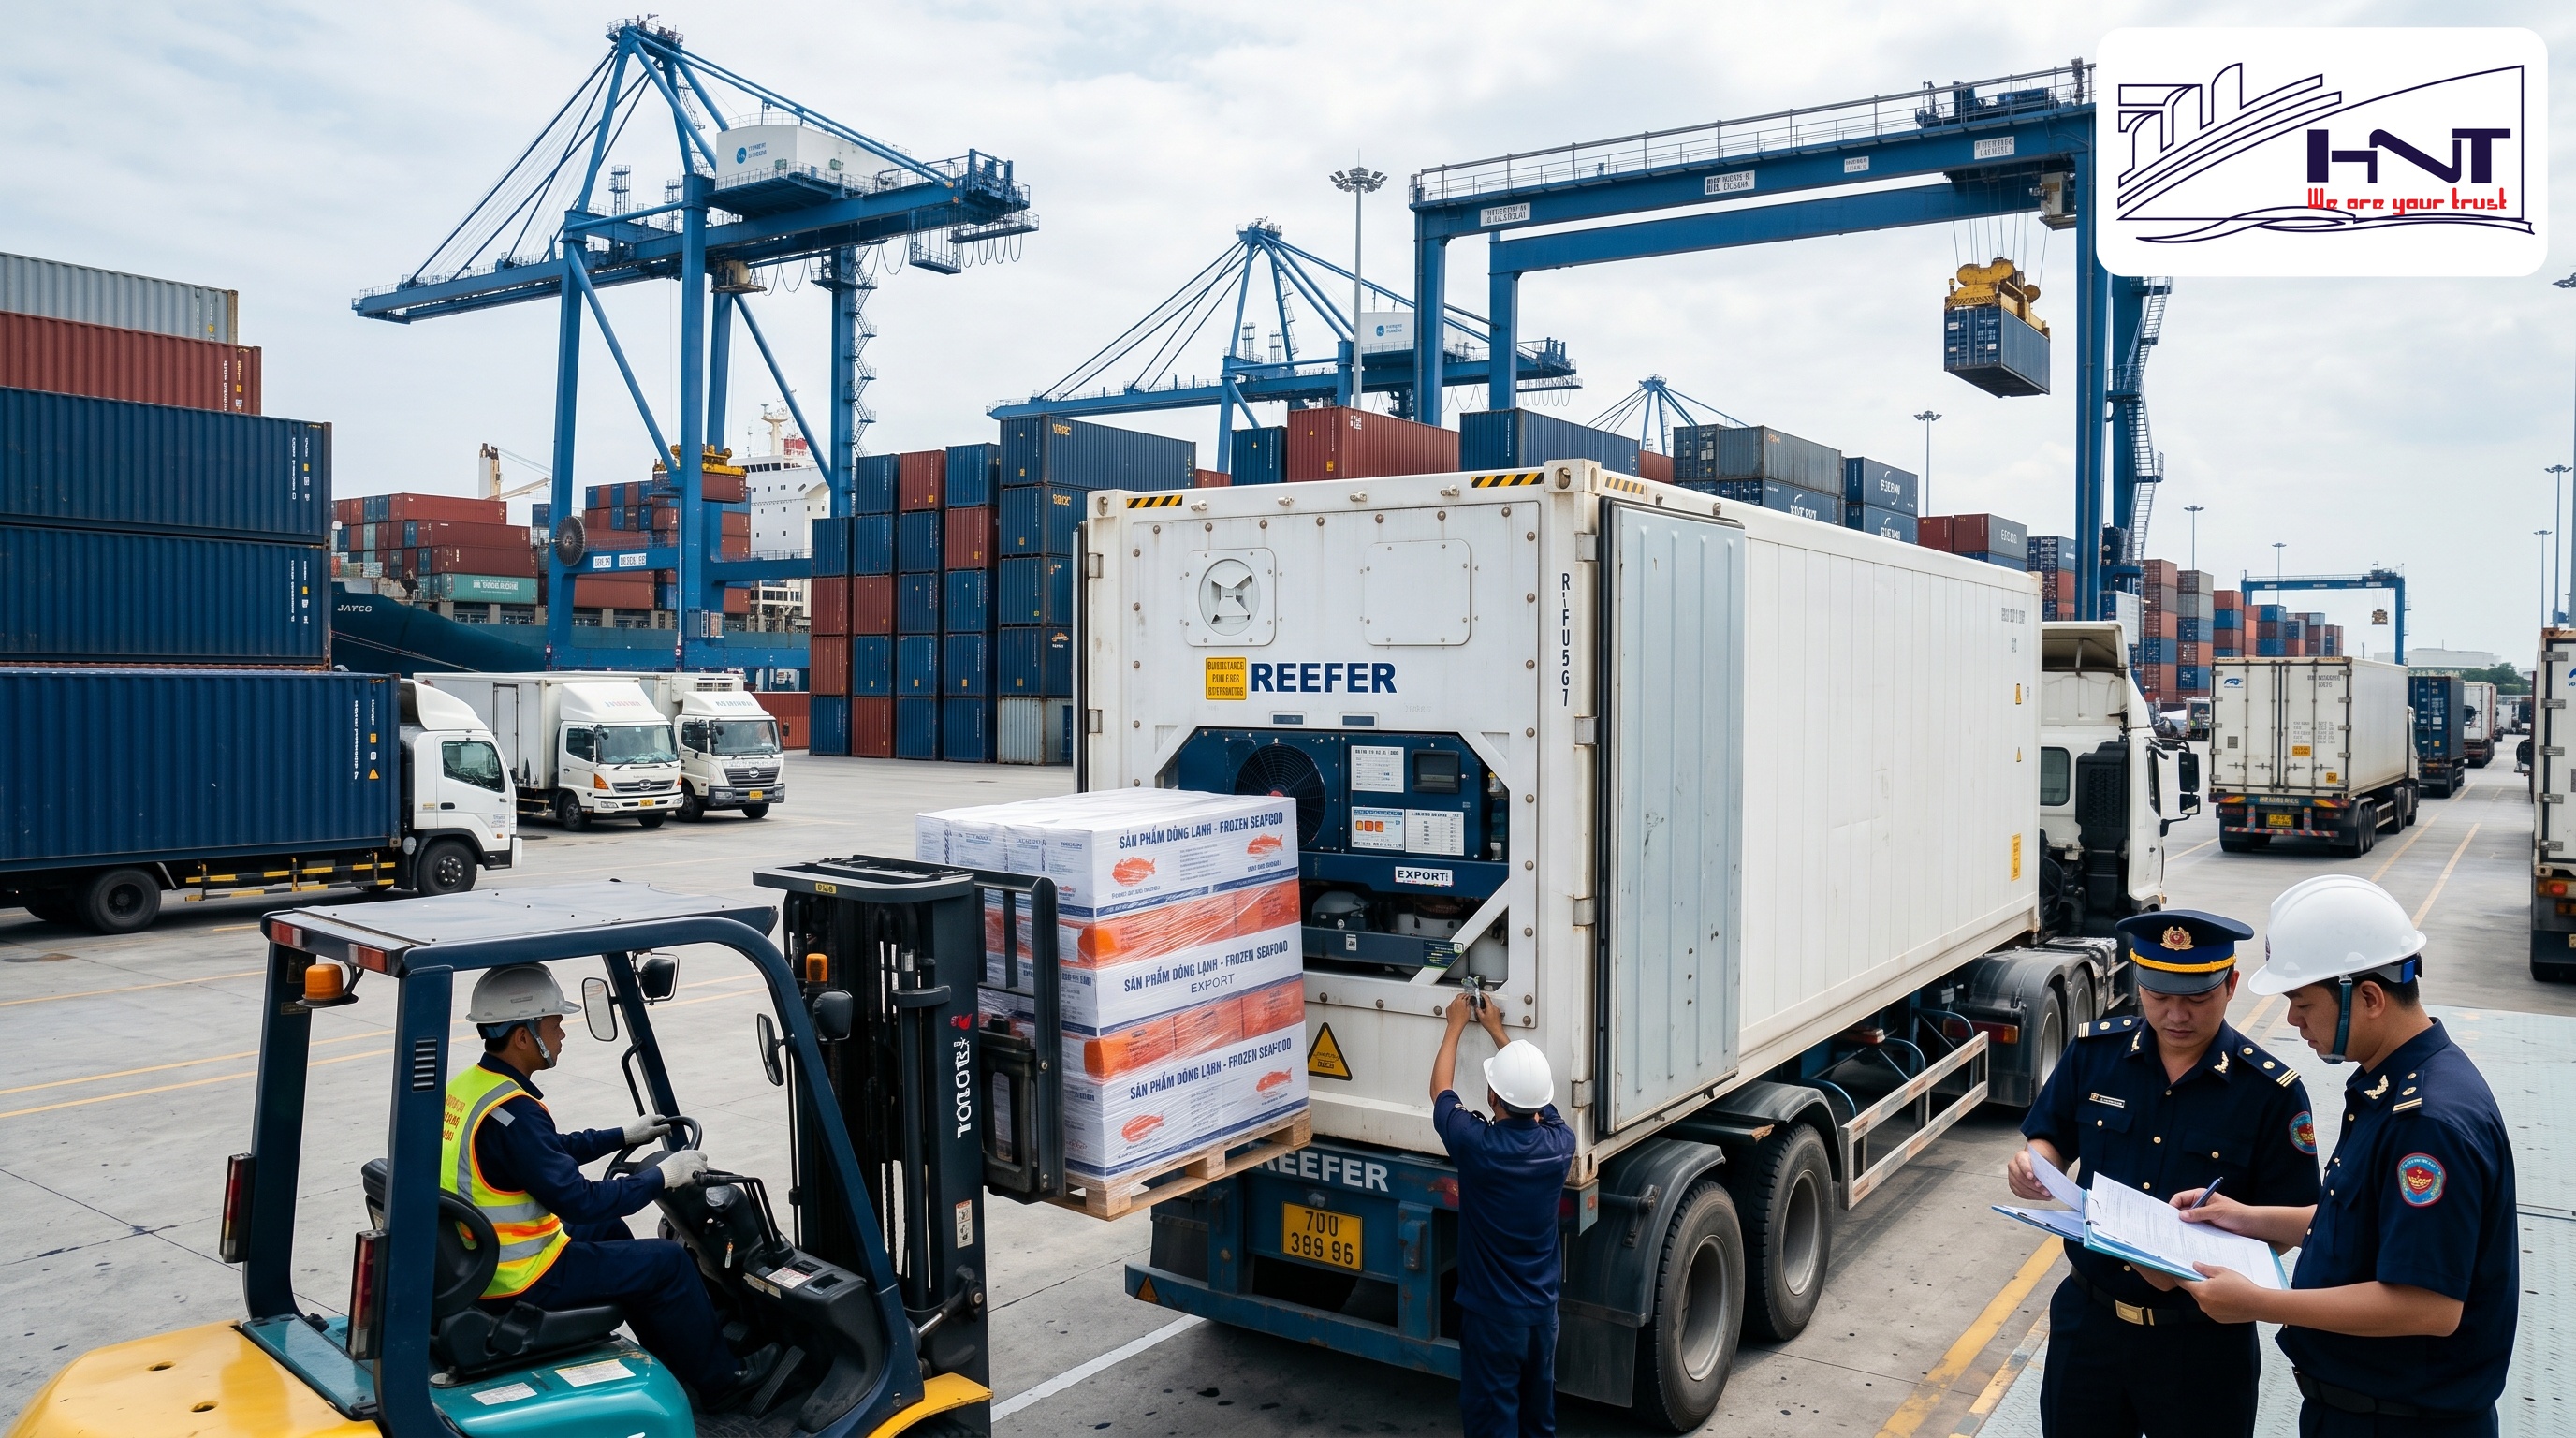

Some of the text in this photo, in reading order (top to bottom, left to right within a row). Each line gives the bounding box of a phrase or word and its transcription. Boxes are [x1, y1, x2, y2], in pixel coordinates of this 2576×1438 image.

[1251, 662, 1398, 694] REEFER
[1220, 817, 1249, 835] FROZEN
[1398, 870, 1446, 882] EXPORT
[1225, 948, 1254, 967] FROZEN
[1191, 973, 1236, 993] EXPORT
[1228, 1049, 1257, 1069] FROZEN
